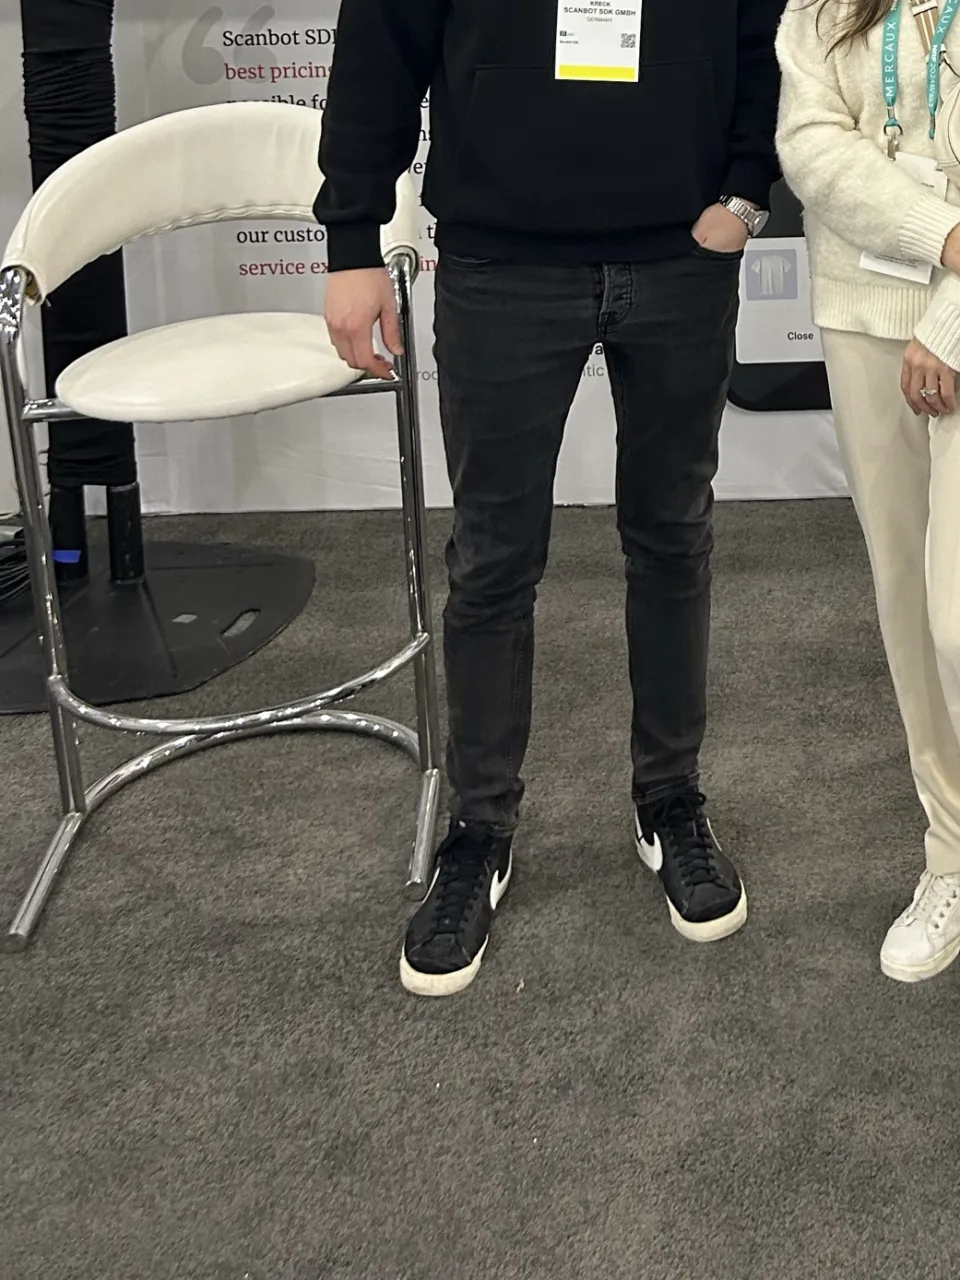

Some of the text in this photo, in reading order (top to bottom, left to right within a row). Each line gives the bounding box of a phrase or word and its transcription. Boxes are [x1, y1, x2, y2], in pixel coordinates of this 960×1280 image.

[564, 6, 597, 14] SCANBOT
[222, 28, 300, 47] Scanbot
[884, 21, 897, 97] MERCAUX
[224, 63, 265, 80] best
[236, 227, 325, 244] our custo
[239, 258, 305, 276] service
[787, 331, 814, 341] Close
